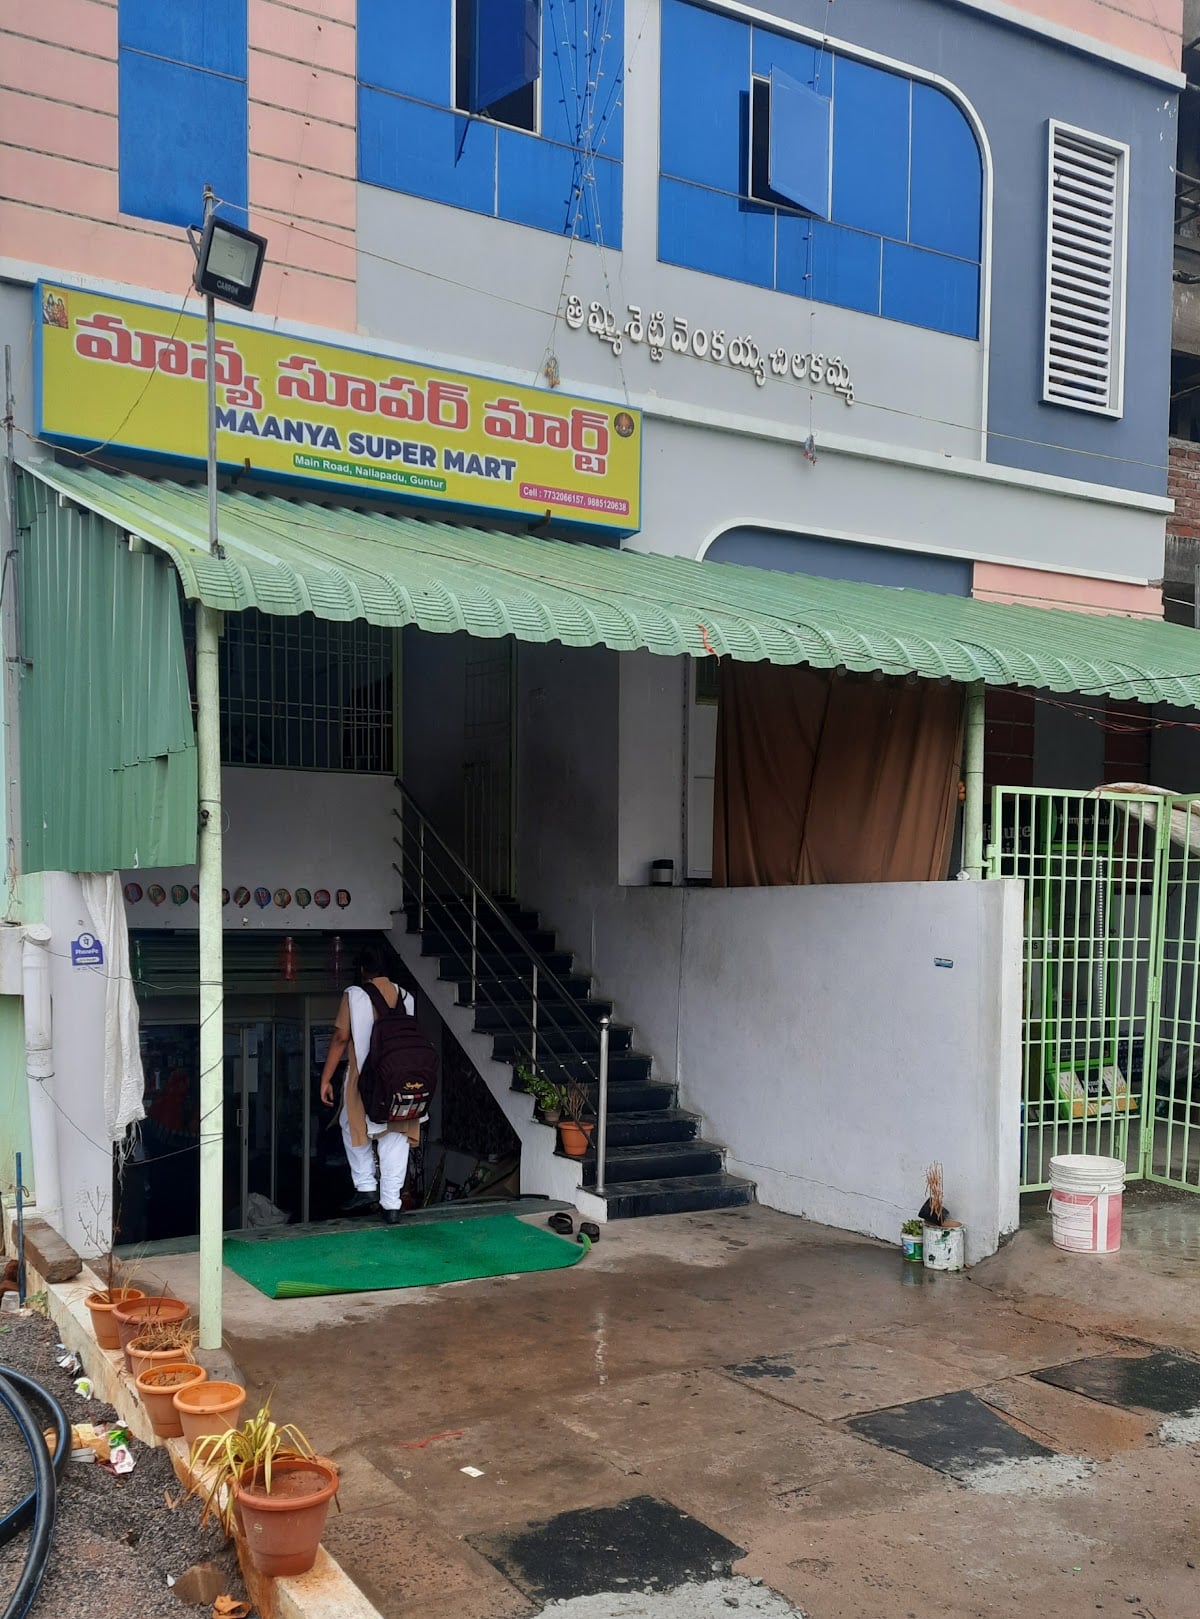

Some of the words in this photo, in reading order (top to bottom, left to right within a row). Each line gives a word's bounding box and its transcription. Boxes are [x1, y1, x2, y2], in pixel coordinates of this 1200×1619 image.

[76, 314, 263, 410] మాన్య
[278, 355, 469, 431] సూపర్
[484, 398, 609, 475] మార్ట్
[216, 406, 341, 450] MAANYA
[349, 432, 436, 468] SUPER
[444, 449, 516, 481] MART
[295, 455, 320, 470] Main
[323, 460, 352, 476] Road,
[355, 465, 407, 485] Nallapadu,
[409, 475, 444, 489] Guntur
[523, 486, 538, 498] Cell
[588, 497, 627, 513] 9885120638
